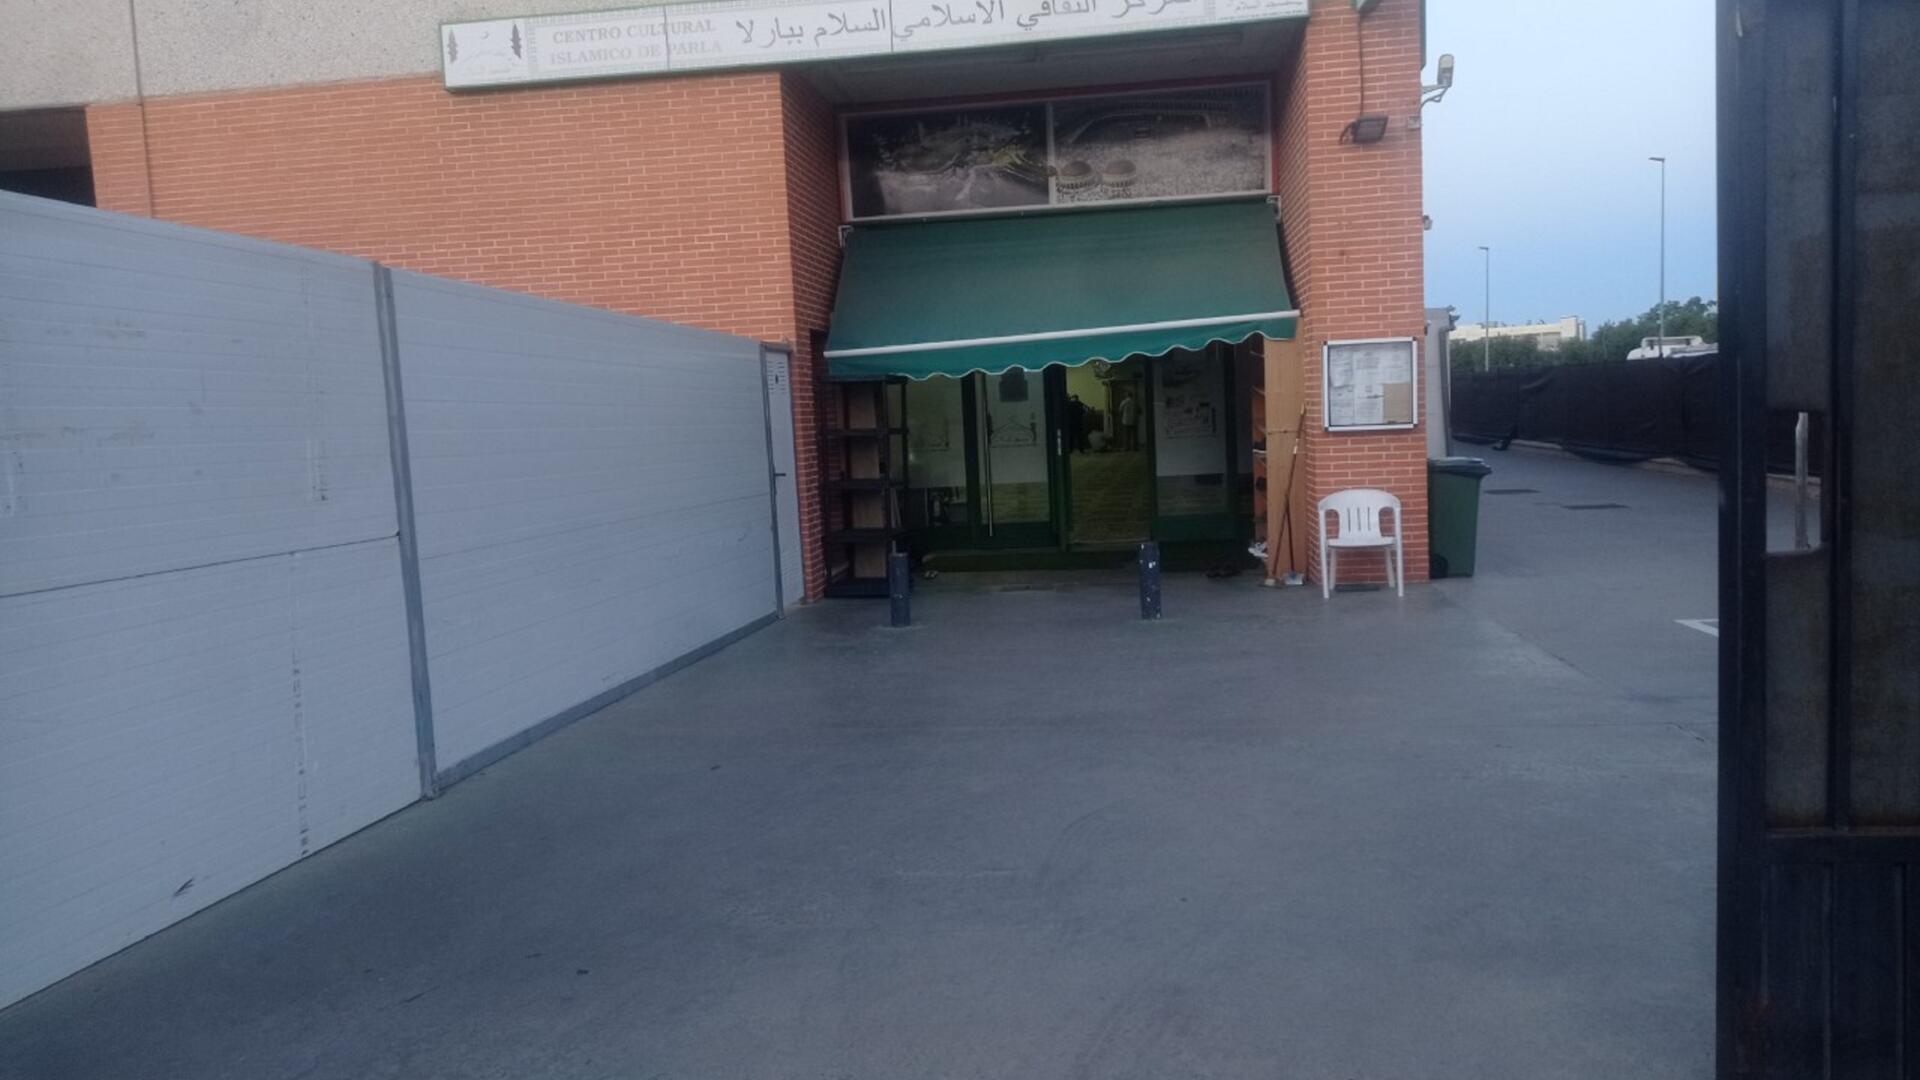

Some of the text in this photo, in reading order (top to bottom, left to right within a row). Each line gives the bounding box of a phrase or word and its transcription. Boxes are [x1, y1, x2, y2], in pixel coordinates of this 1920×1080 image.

[552, 19, 717, 45] CENTRO CULTURAL
[813, 7, 887, 47] السلام
[549, 40, 723, 66] ISLAMICO DE PARLA
